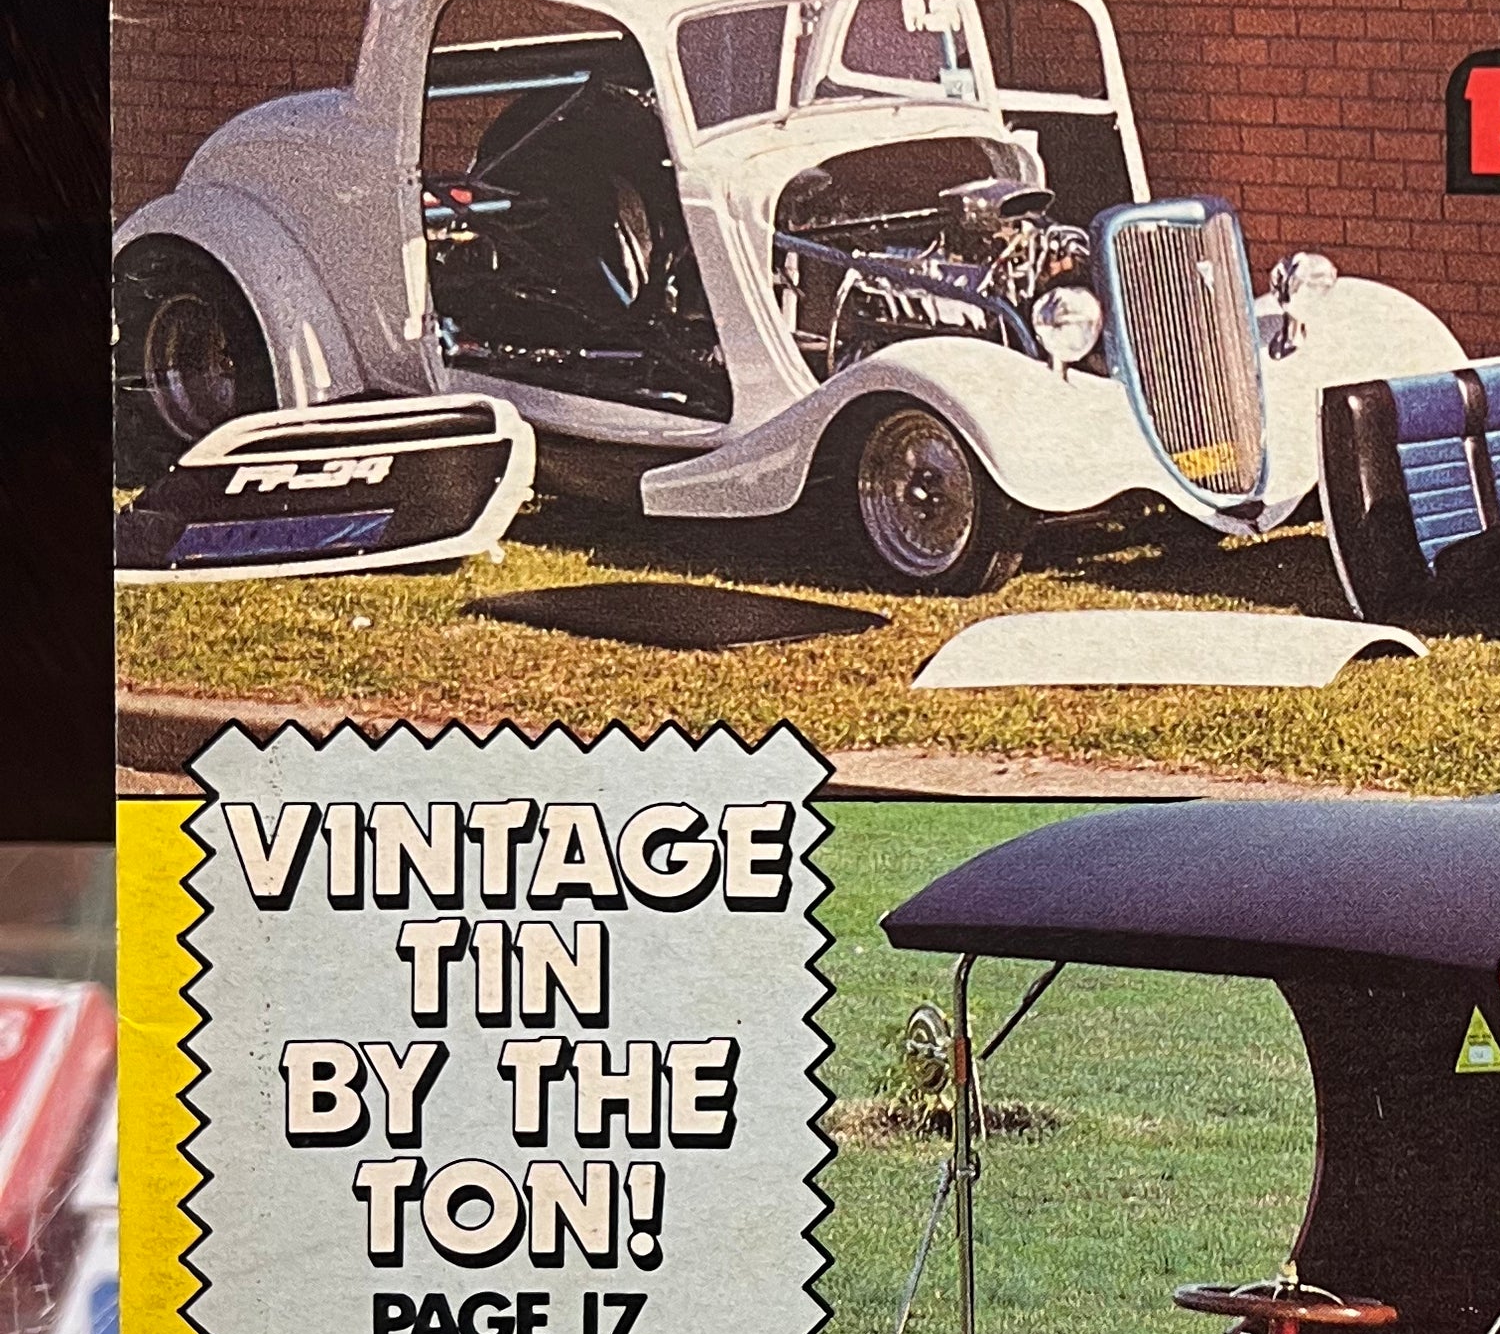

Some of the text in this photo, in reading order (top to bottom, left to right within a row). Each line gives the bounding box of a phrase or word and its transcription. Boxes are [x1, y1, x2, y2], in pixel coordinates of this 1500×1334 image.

[221, 797, 797, 912] VINTAGE
[396, 916, 610, 1029] TIN
[281, 1035, 742, 1150] BY THE
[352, 1156, 665, 1272] TON!
